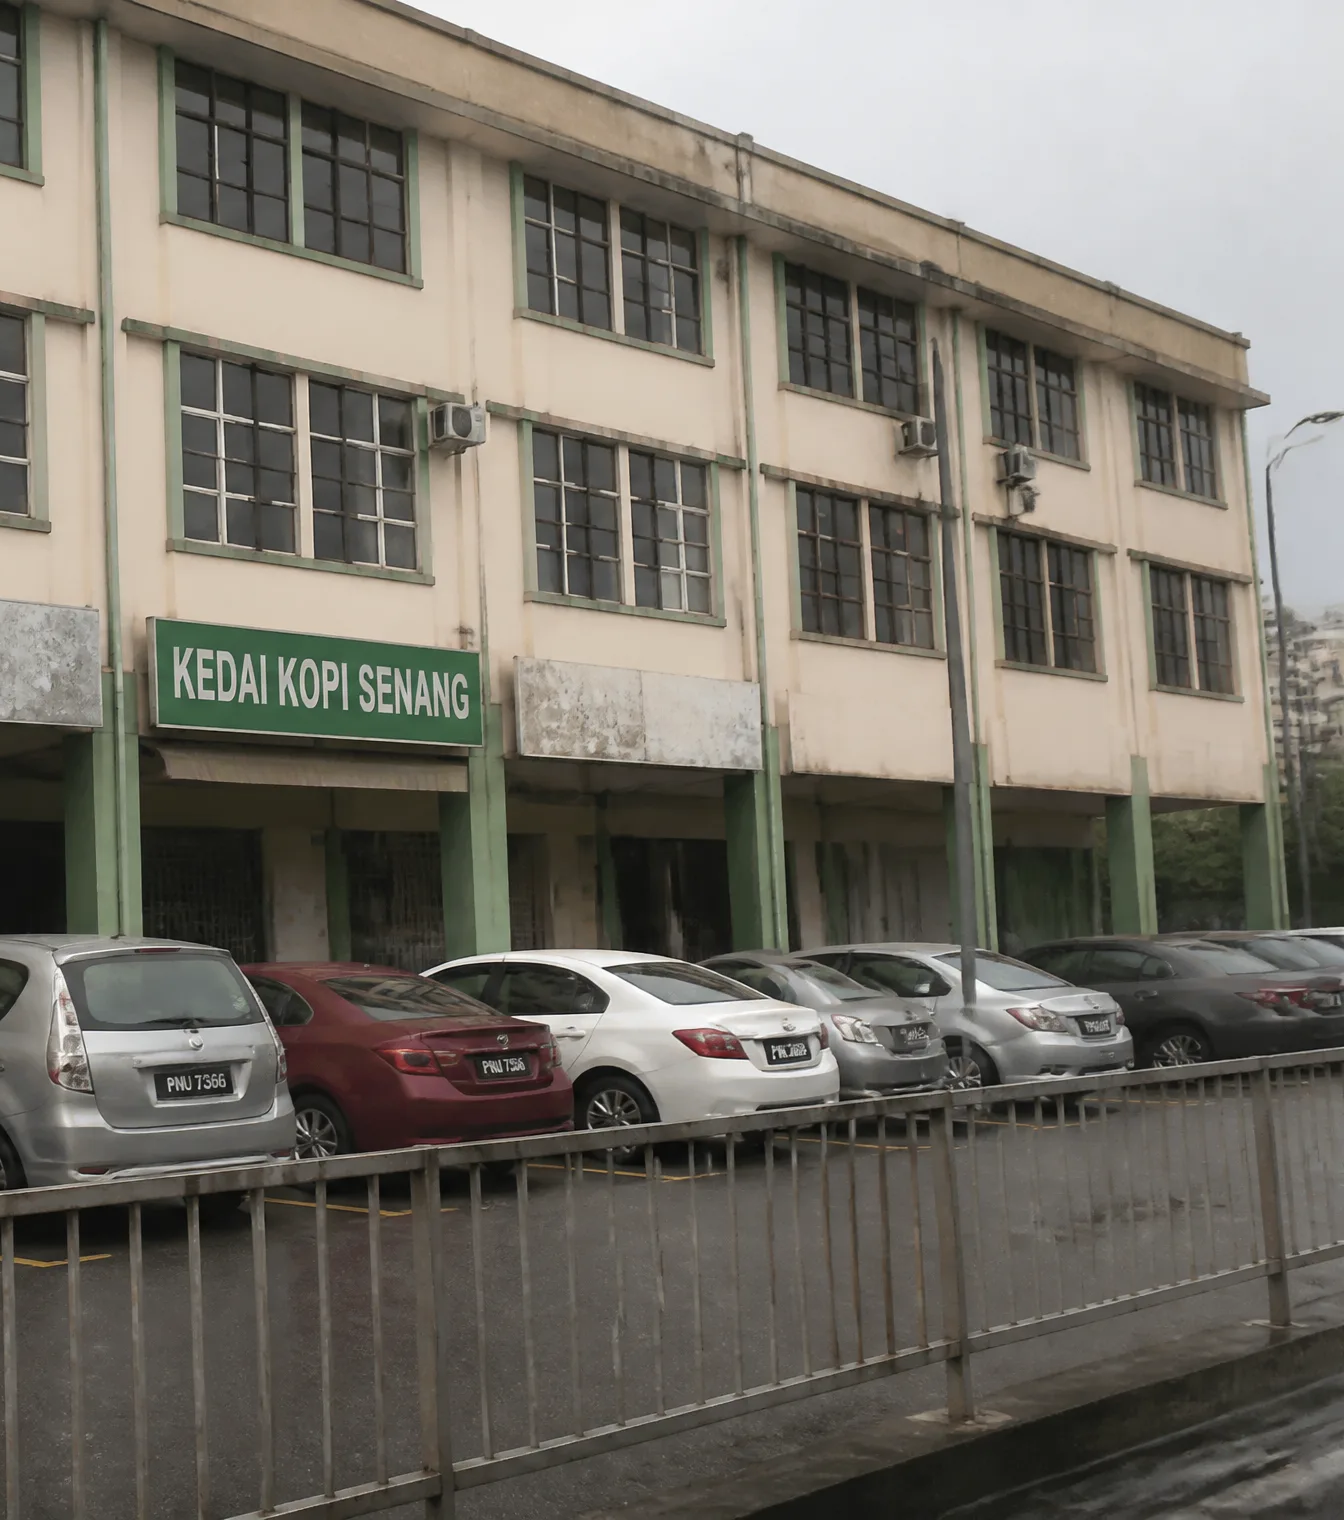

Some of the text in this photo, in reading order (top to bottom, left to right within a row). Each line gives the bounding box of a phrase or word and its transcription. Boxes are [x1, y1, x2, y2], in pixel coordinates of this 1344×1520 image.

[173, 646, 470, 720] KEDAI KOPI SENANG
[166, 1075, 192, 1093] PNU
